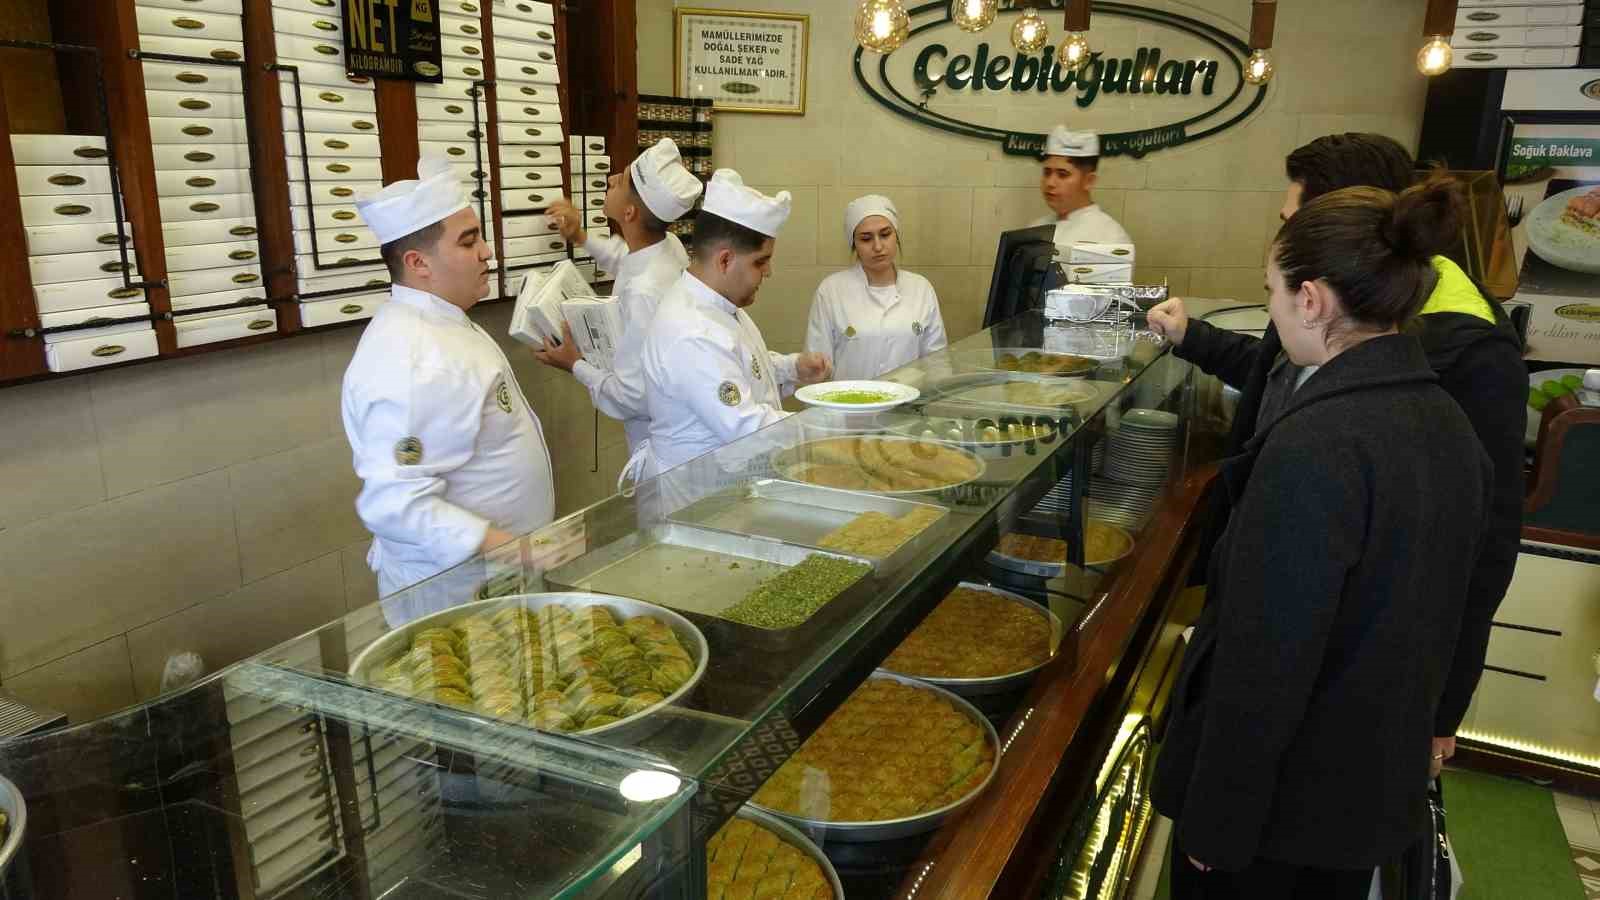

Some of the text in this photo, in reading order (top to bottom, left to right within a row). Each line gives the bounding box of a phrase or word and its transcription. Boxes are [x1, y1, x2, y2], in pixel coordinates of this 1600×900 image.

[415, 2, 428, 13] KG
[347, 0, 398, 54] NET
[703, 42, 735, 53] DOĞAL
[769, 47, 780, 55] ve
[719, 55, 743, 64] SADE
[1513, 144, 1593, 159] Soğuk Baklava
